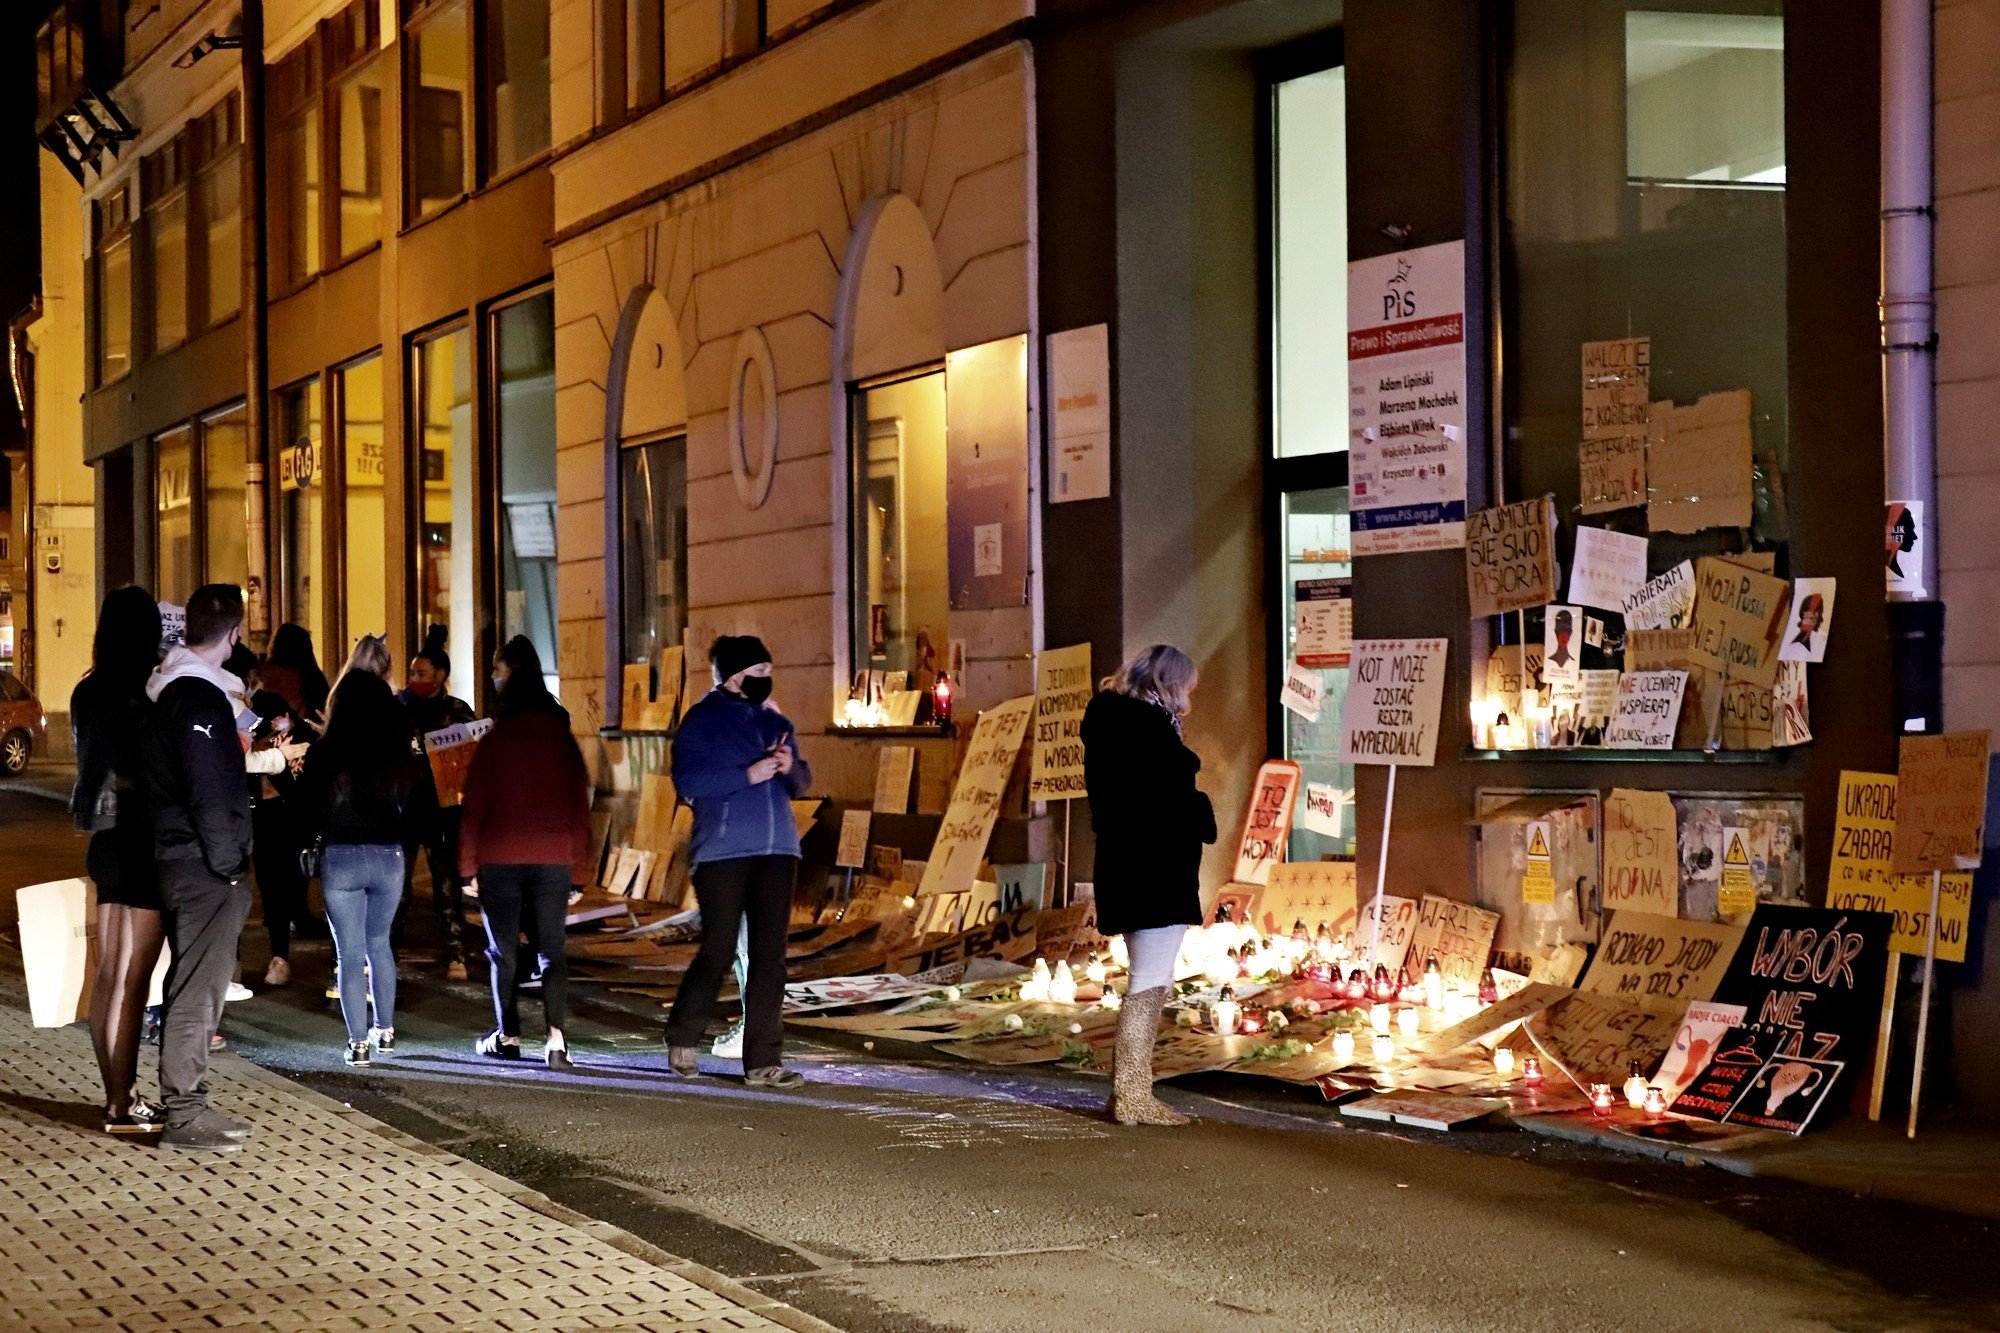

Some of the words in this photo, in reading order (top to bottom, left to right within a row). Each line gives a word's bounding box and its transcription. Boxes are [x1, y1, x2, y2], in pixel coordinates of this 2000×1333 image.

[1382, 289, 1416, 320] PiS
[1350, 335, 1379, 351] Prawo
[1385, 319, 1460, 347] Sprawiedliwość
[1379, 377, 1402, 392] Adam
[1404, 371, 1434, 392] Lipiński
[1380, 400, 1416, 415] Marzena
[1419, 391, 1459, 410] Machałek
[1380, 422, 1410, 437] Elżbieta
[1411, 417, 1436, 431] Witek
[1381, 446, 1412, 460] Wojciech
[1382, 468, 1415, 480] Krzysztof
[1375, 507, 1439, 523] www.PiS.org.pl
[1466, 501, 1542, 540] ZAJMIJCI
[47, 537, 58, 545] 18
[1470, 538, 1498, 567] SIĘ
[1502, 529, 1539, 562] SWO
[1622, 566, 1683, 614] WYBIERAM
[1046, 664, 1087, 691] JEDYNYM
[1357, 657, 1384, 683] KOT
[1391, 655, 1428, 683] MOŻE
[1373, 684, 1415, 706] ZOSTAĆ
[1037, 721, 1059, 742] JEST
[1063, 719, 1083, 739] WOL
[1377, 709, 1413, 726] RESZTA
[1351, 723, 1425, 757] WYPIERDALAĆ
[1044, 744, 1085, 769] WYBORU
[1031, 774, 1086, 794] #PIEKŁOKOB
[1261, 785, 1287, 809] TO
[1249, 808, 1281, 830] JEST
[1613, 797, 1634, 830] TO
[1623, 827, 1666, 862] JEST
[1837, 827, 1893, 861] ZABRA
[1842, 866, 1853, 880] CO
[1858, 868, 1873, 883] NIE
[1932, 877, 1970, 904] SZAJ!
[1420, 899, 1469, 935] WARA
[1909, 912, 1961, 944] STWU
[1602, 931, 1665, 967] ROZKŁAD
[1664, 936, 1724, 972] JAZDY
[1751, 915, 1864, 990] WYBÓR
[1616, 973, 1641, 994] NA
[1688, 1008, 1710, 1023] MOJE
[1711, 1012, 1740, 1026] CIAŁO
[1759, 989, 1818, 1030] NIE
